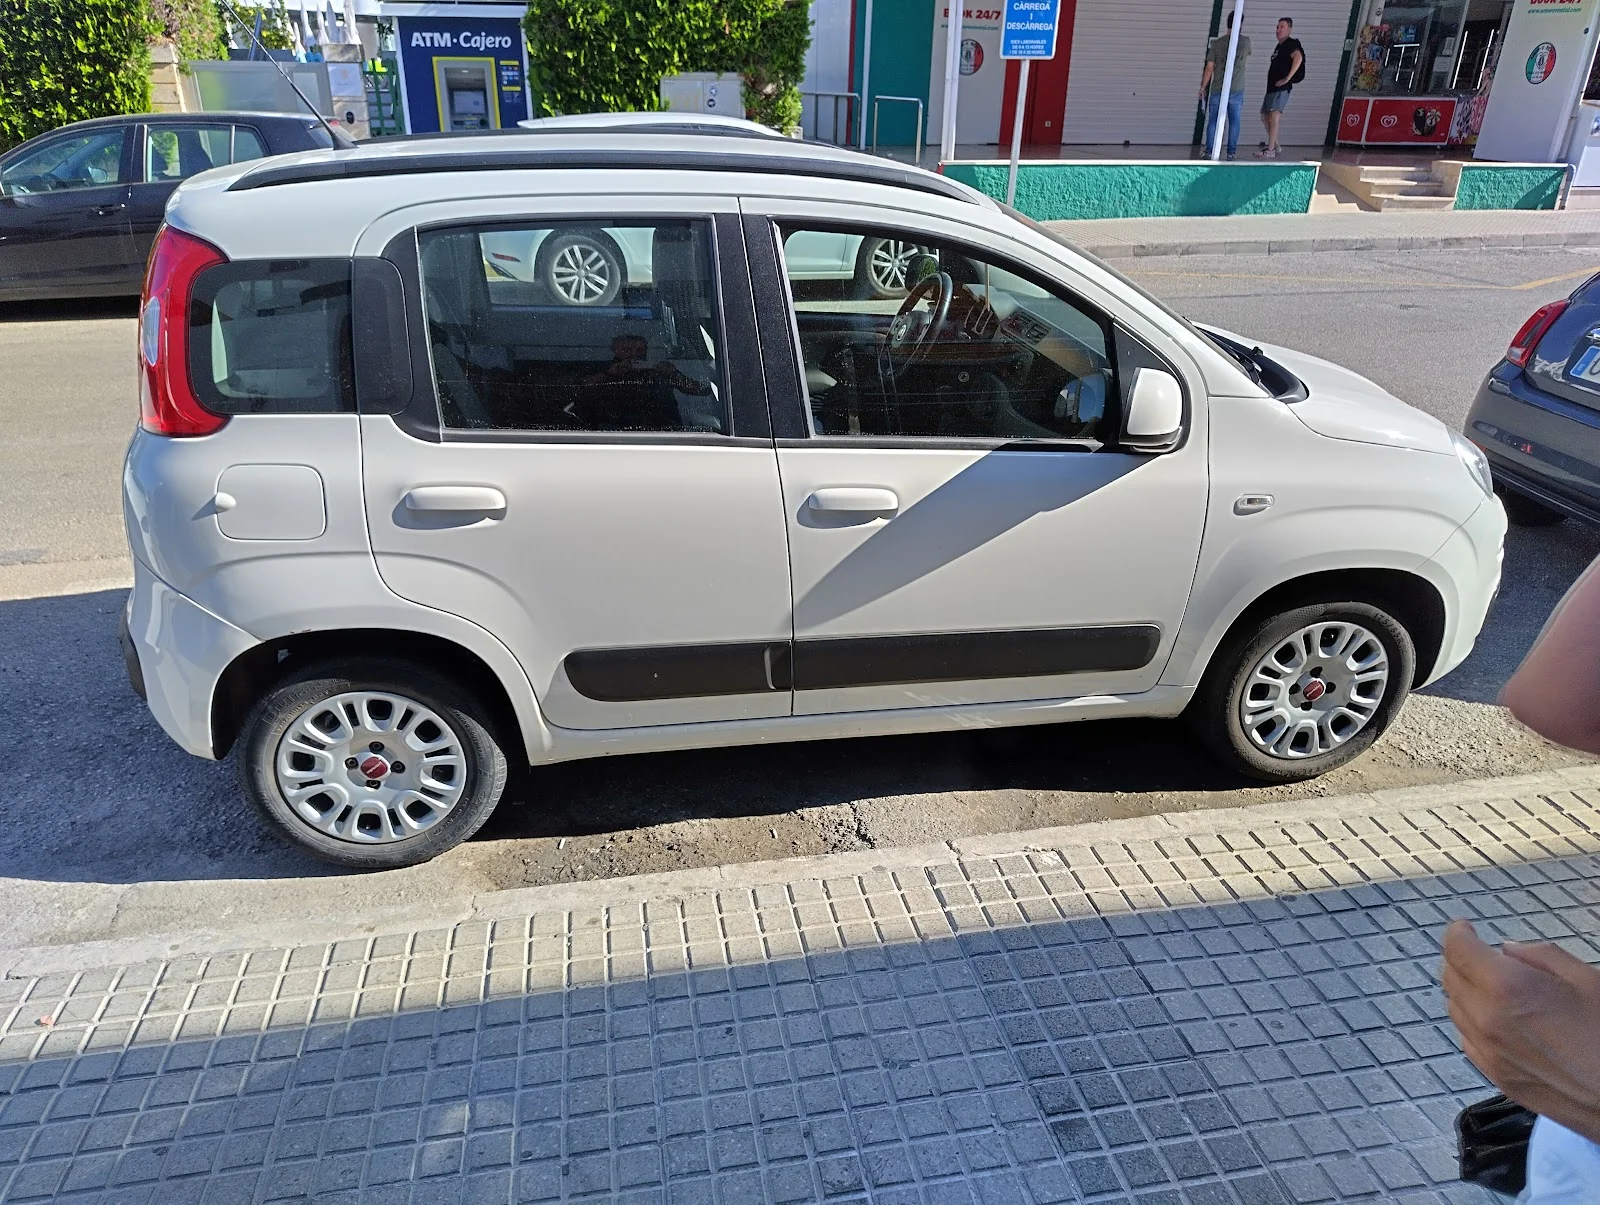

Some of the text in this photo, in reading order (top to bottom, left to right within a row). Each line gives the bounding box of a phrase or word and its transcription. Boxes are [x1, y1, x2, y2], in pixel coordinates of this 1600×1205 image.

[1013, 1, 1050, 10] CÀRREGA
[943, 8, 1001, 20] BK 24/7
[1006, 20, 1053, 31] DESCÀRREGA
